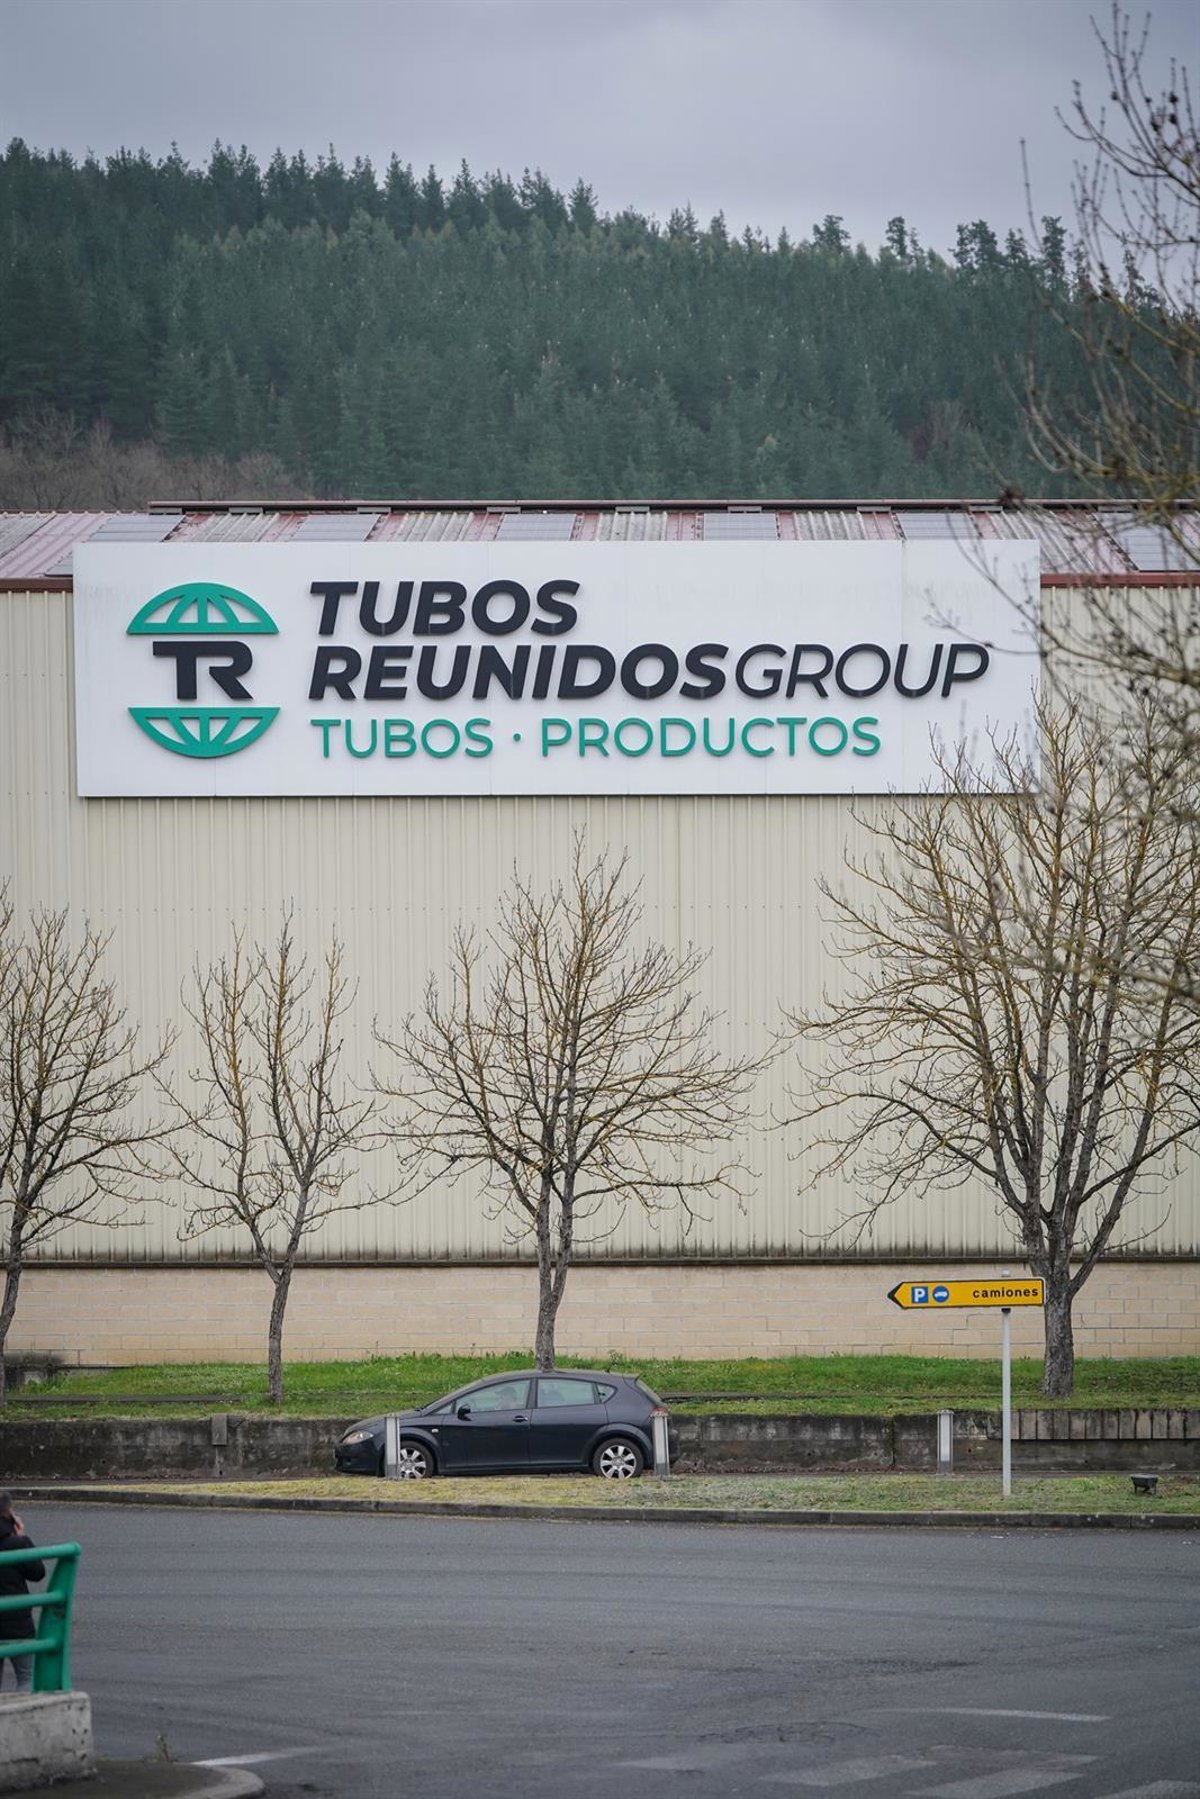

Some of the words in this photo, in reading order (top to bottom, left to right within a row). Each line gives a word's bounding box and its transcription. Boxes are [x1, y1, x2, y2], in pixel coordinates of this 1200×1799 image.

[309, 579, 581, 636] TUBOS
[152, 640, 254, 701] TR
[310, 717, 494, 759] TUBOS
[541, 716, 881, 758] PRODUCTOS
[914, 1288, 926, 1303] P
[972, 1287, 1039, 1299] camiones
